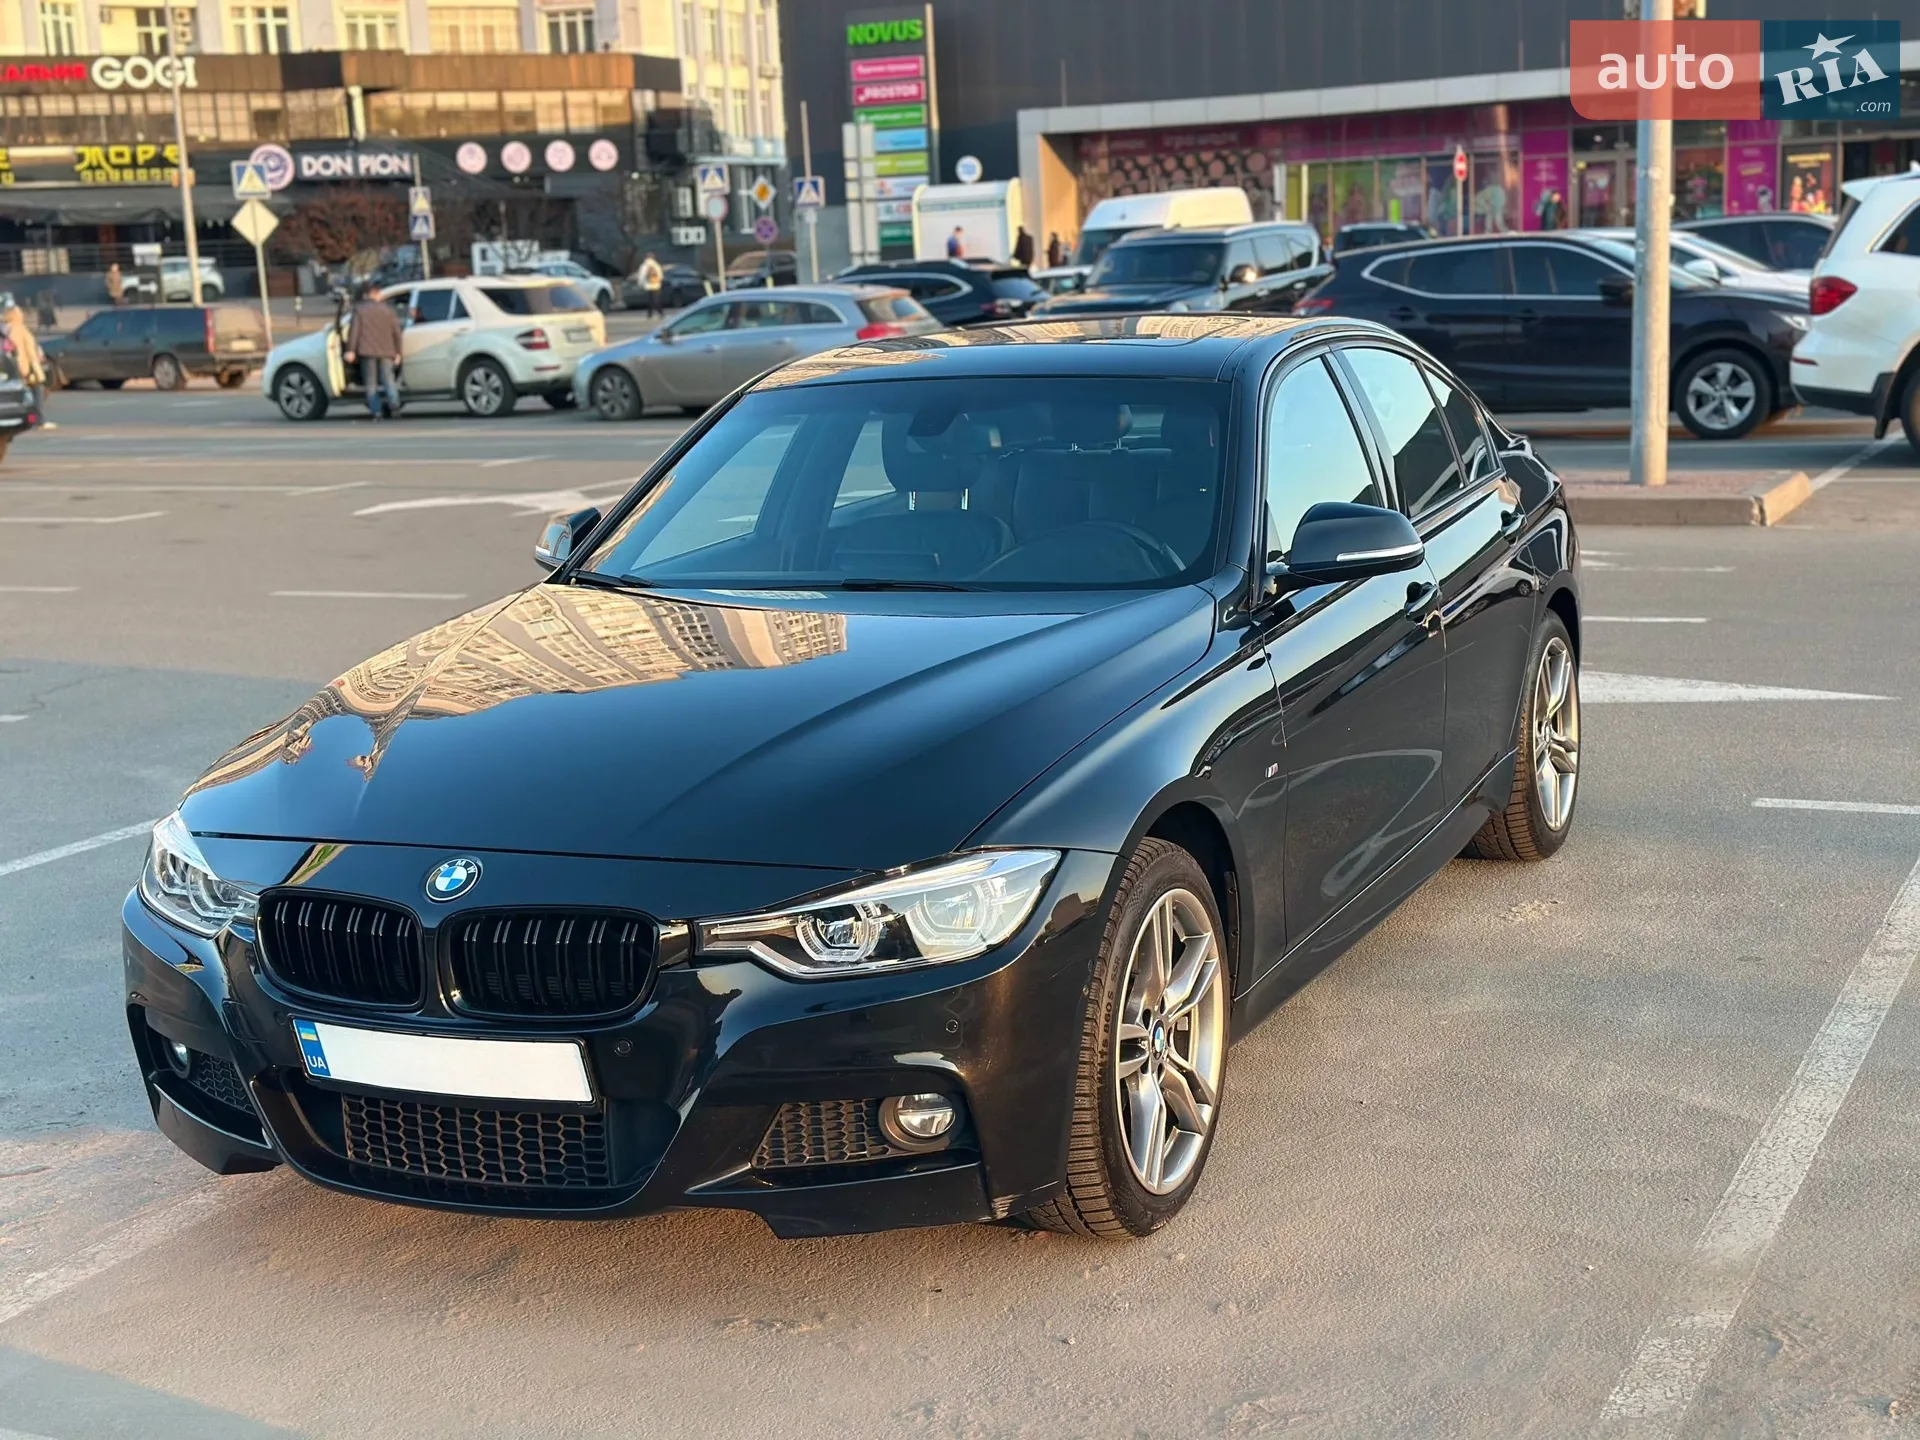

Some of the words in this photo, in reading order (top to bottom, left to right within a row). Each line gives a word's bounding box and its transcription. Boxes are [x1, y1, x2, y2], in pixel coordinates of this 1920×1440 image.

[847, 19, 924, 46] NOVUS
[91, 55, 198, 90] GOGI
[301, 154, 354, 177] DON
[358, 153, 411, 176] PION
[439, 859, 476, 874] BMW
[307, 1055, 327, 1069] UA
